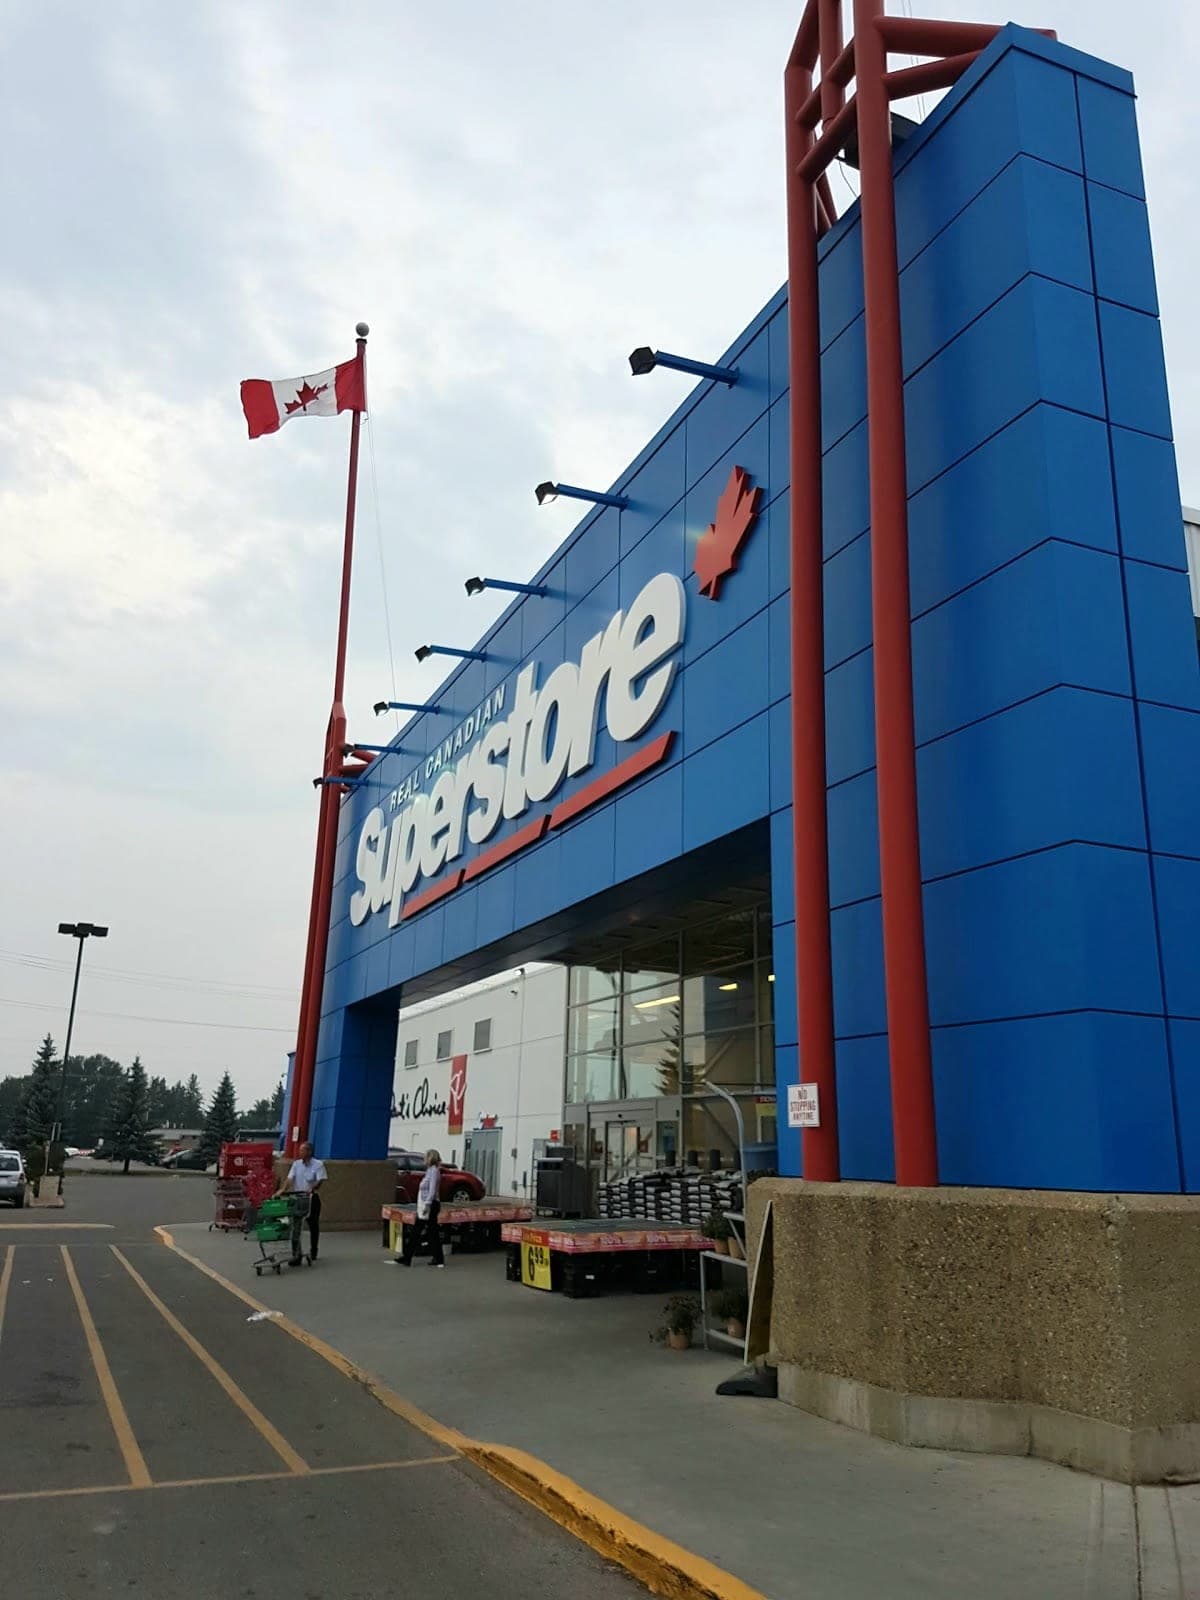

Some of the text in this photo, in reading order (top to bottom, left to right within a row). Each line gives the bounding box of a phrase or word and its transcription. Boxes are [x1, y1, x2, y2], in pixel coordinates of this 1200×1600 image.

[350, 572, 686, 929] Superstore
[390, 684, 507, 812] REAL CANADIAN
[790, 1100, 817, 1113] STOPPING
[798, 1089, 808, 1100] NO
